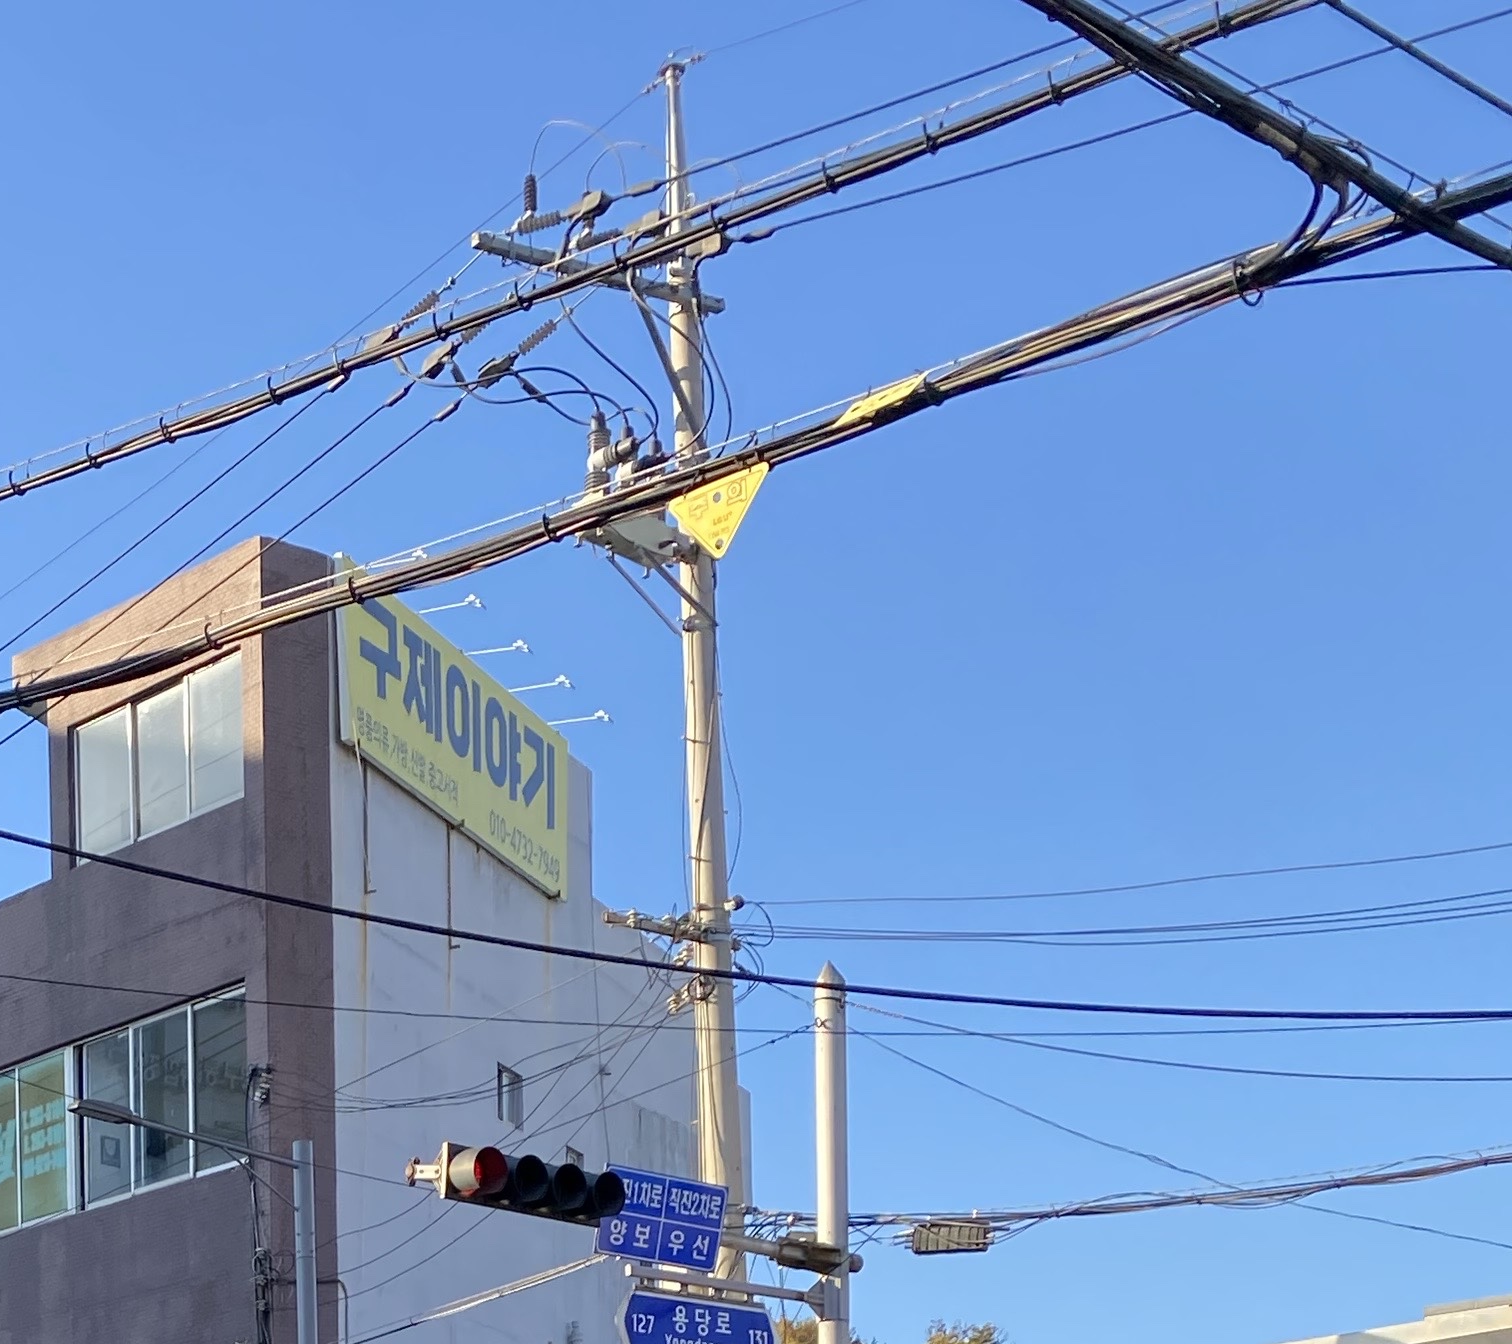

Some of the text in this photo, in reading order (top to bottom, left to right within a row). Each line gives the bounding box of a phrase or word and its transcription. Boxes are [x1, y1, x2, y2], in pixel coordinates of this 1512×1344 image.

[359, 598, 556, 831] 구제이야기
[668, 1187, 722, 1220] 직진2차로
[630, 1312, 655, 1335] 127
[672, 1305, 732, 1336] 용당로
